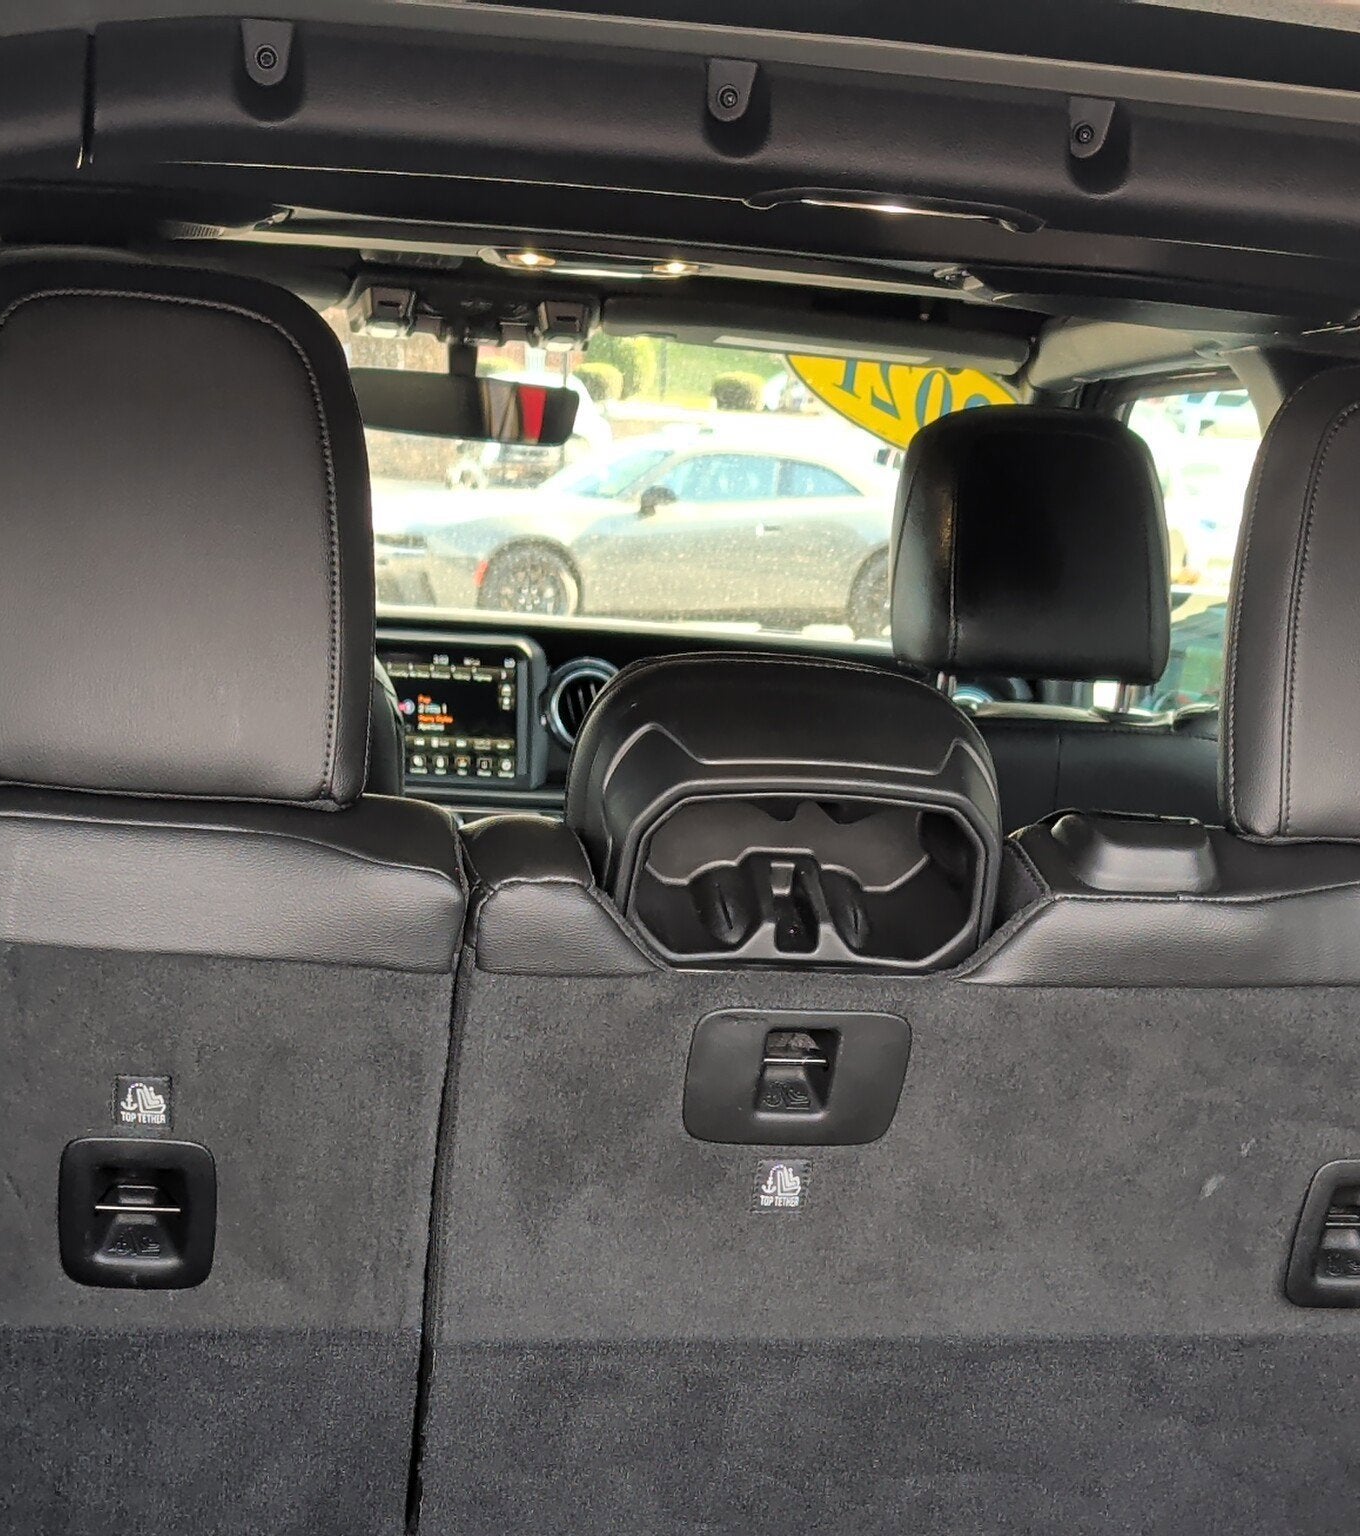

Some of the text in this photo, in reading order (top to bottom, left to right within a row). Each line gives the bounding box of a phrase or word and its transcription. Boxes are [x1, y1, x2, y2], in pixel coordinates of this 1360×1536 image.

[120, 1110, 166, 1124] TOP TETHER
[760, 1194, 800, 1207] TOP TETHER
